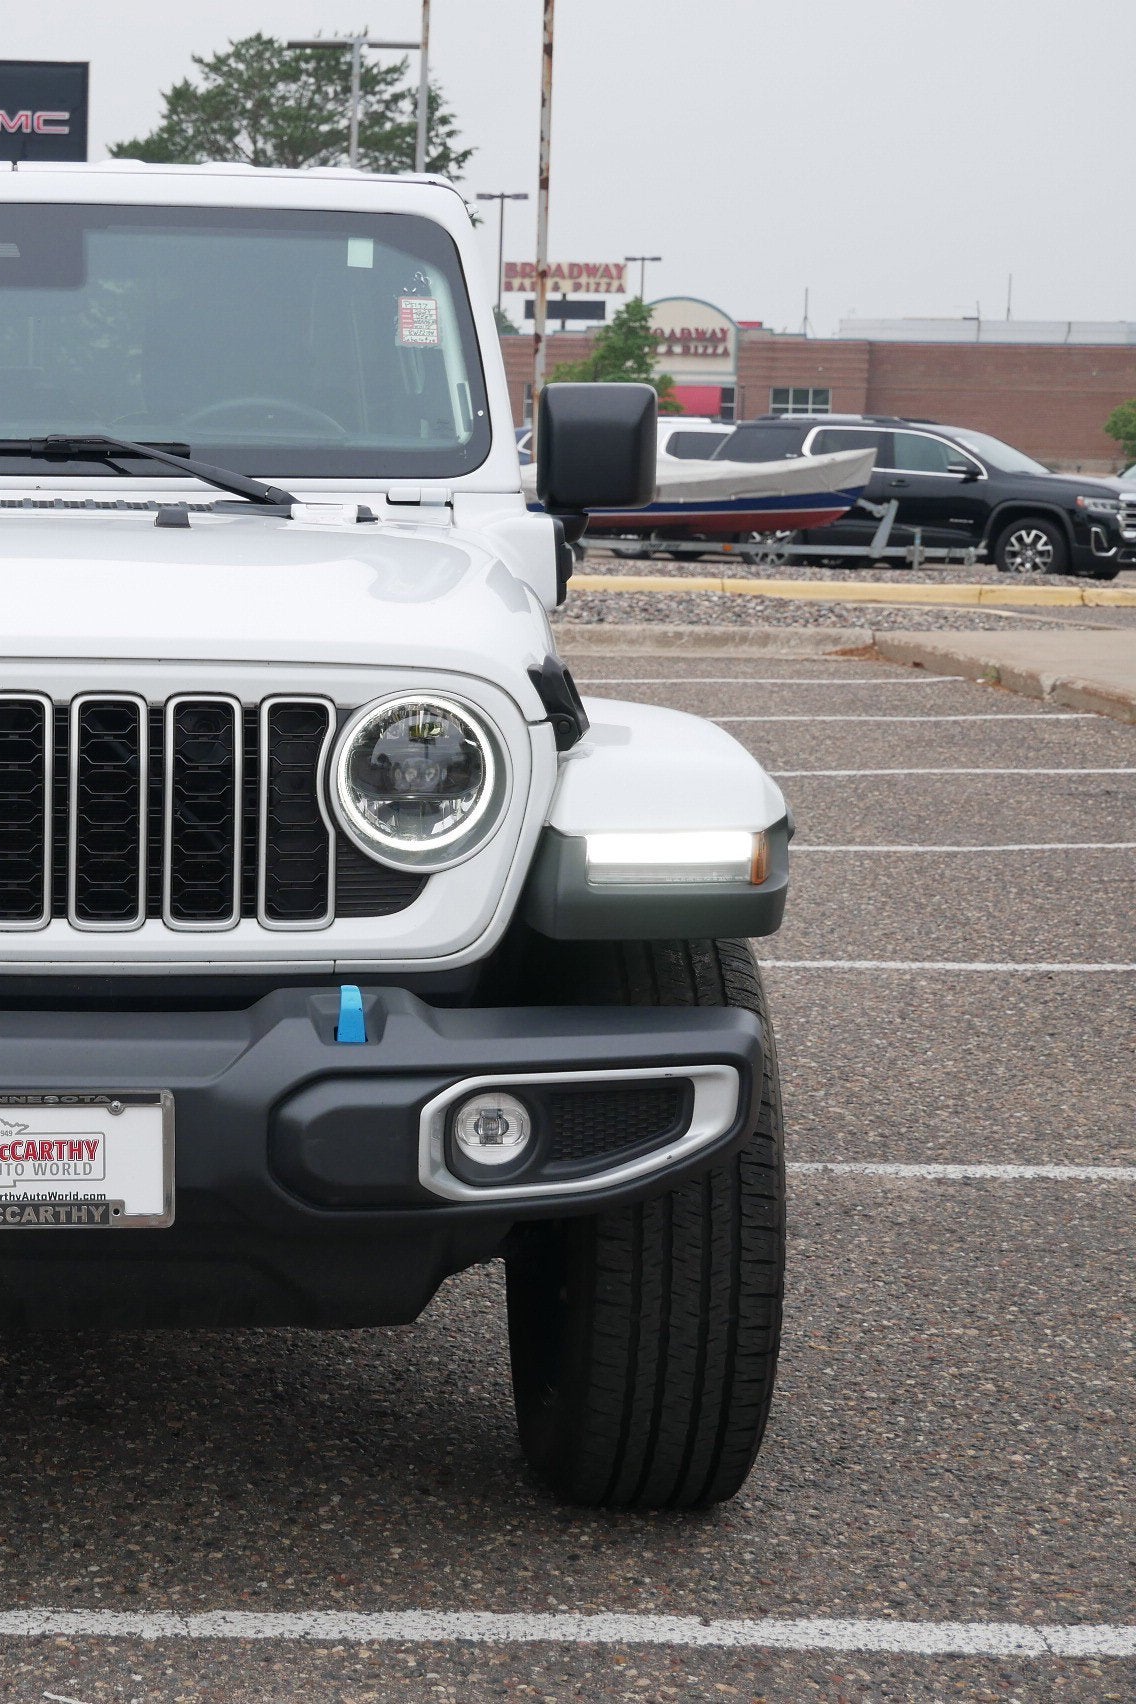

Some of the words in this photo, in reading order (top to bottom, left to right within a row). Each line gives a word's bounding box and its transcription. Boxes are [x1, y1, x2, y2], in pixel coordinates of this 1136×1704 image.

[573, 282, 626, 294] PIZZA
[643, 327, 729, 341] OADWAY
[33, 1162, 93, 1176] WORLD
